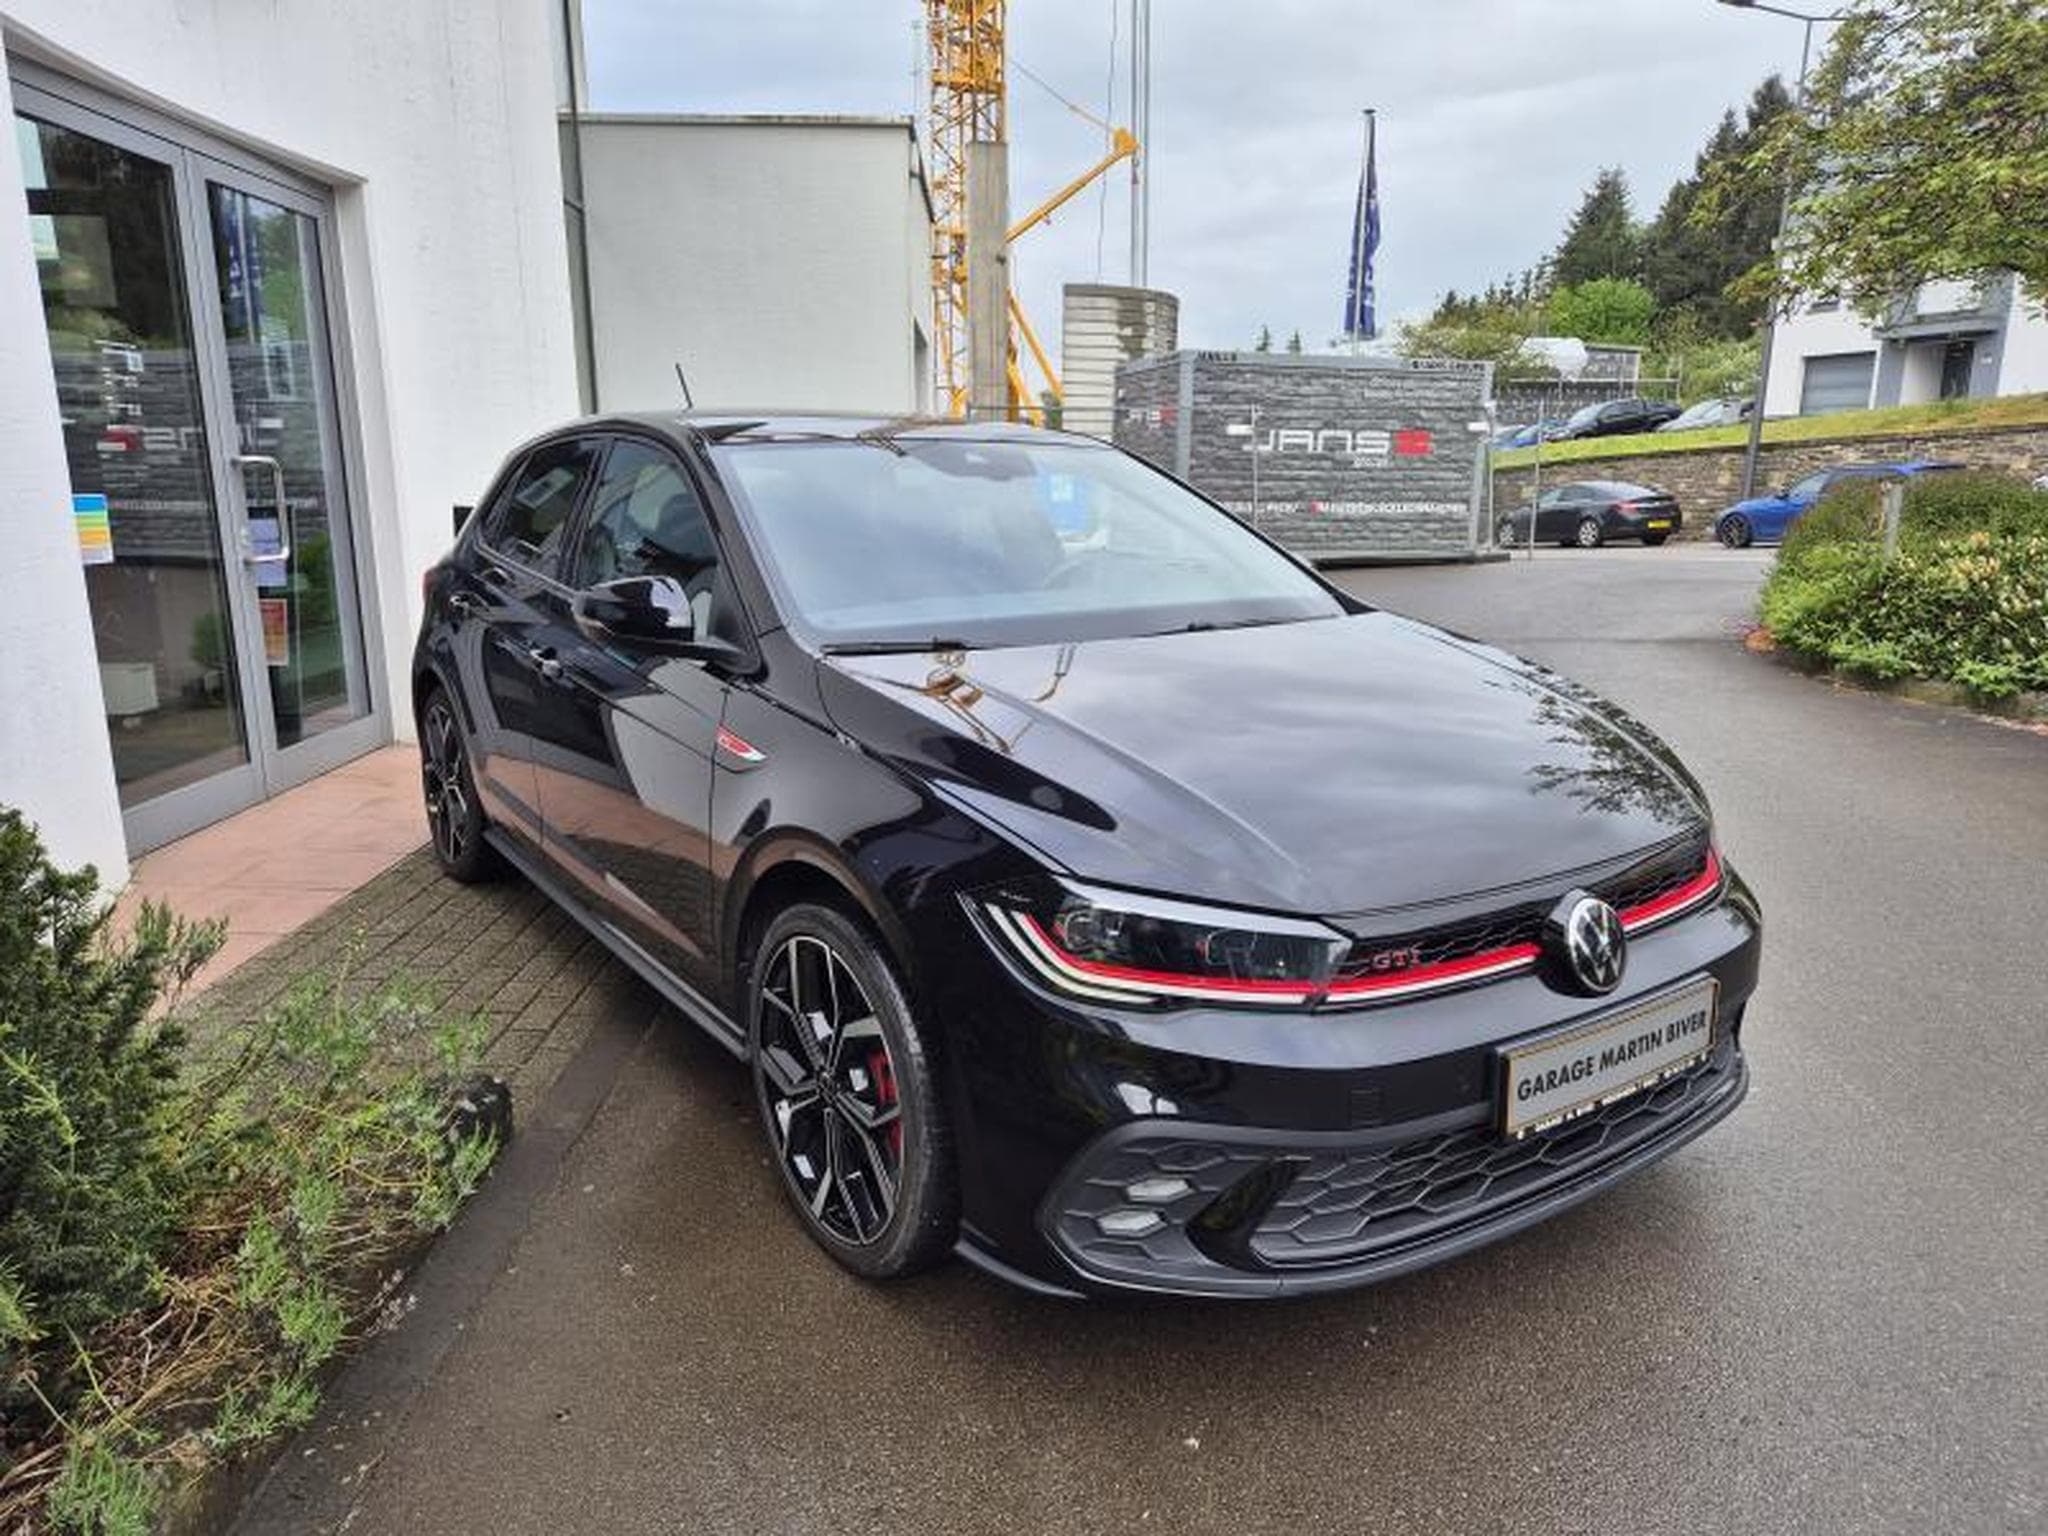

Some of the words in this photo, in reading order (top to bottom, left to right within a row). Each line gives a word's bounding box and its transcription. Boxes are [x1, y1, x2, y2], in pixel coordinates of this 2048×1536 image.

[1242, 429, 1391, 454] JANS
[1372, 947, 1421, 969] GTI
[1517, 1056, 1595, 1101] GARAGE
[1599, 1028, 1663, 1071] MARTIN
[1666, 1011, 1707, 1043] BIVER
